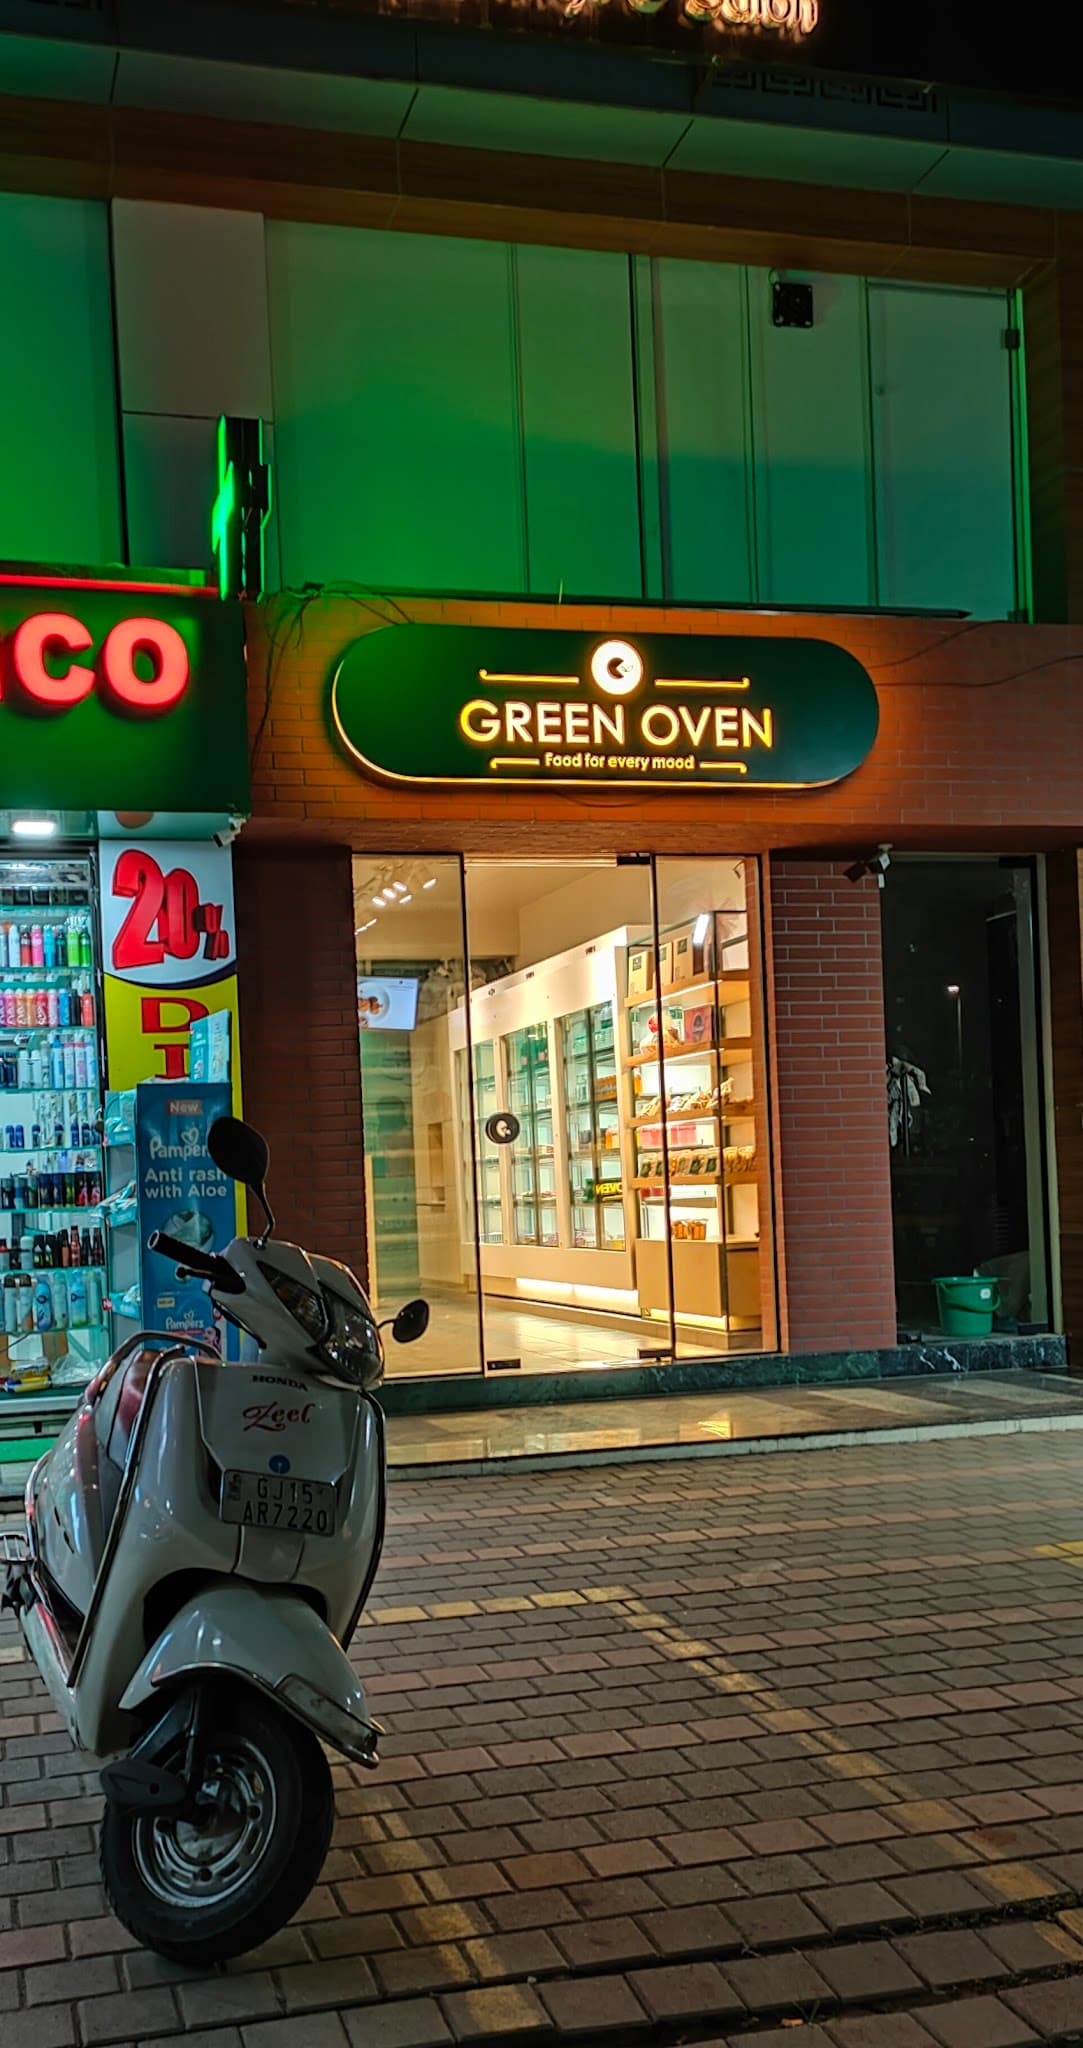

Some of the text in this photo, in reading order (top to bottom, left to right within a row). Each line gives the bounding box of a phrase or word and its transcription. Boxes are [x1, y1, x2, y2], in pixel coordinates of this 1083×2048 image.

[0, 611, 191, 709] CO
[460, 699, 772, 747] GREEN OVEN
[545, 752, 695, 771] Food for every mood
[112, 849, 230, 970] 20%
[169, 1102, 199, 1114] New
[149, 1135, 212, 1161] Pamper
[145, 1168, 183, 1182] Anti
[145, 1184, 227, 1199] with Aloe
[165, 1316, 204, 1331] Pampers
[252, 1375, 308, 1391] HONDA
[242, 1401, 316, 1432] Zeel
[257, 1478, 313, 1505] GJ15
[243, 1500, 327, 1532] AR7220
